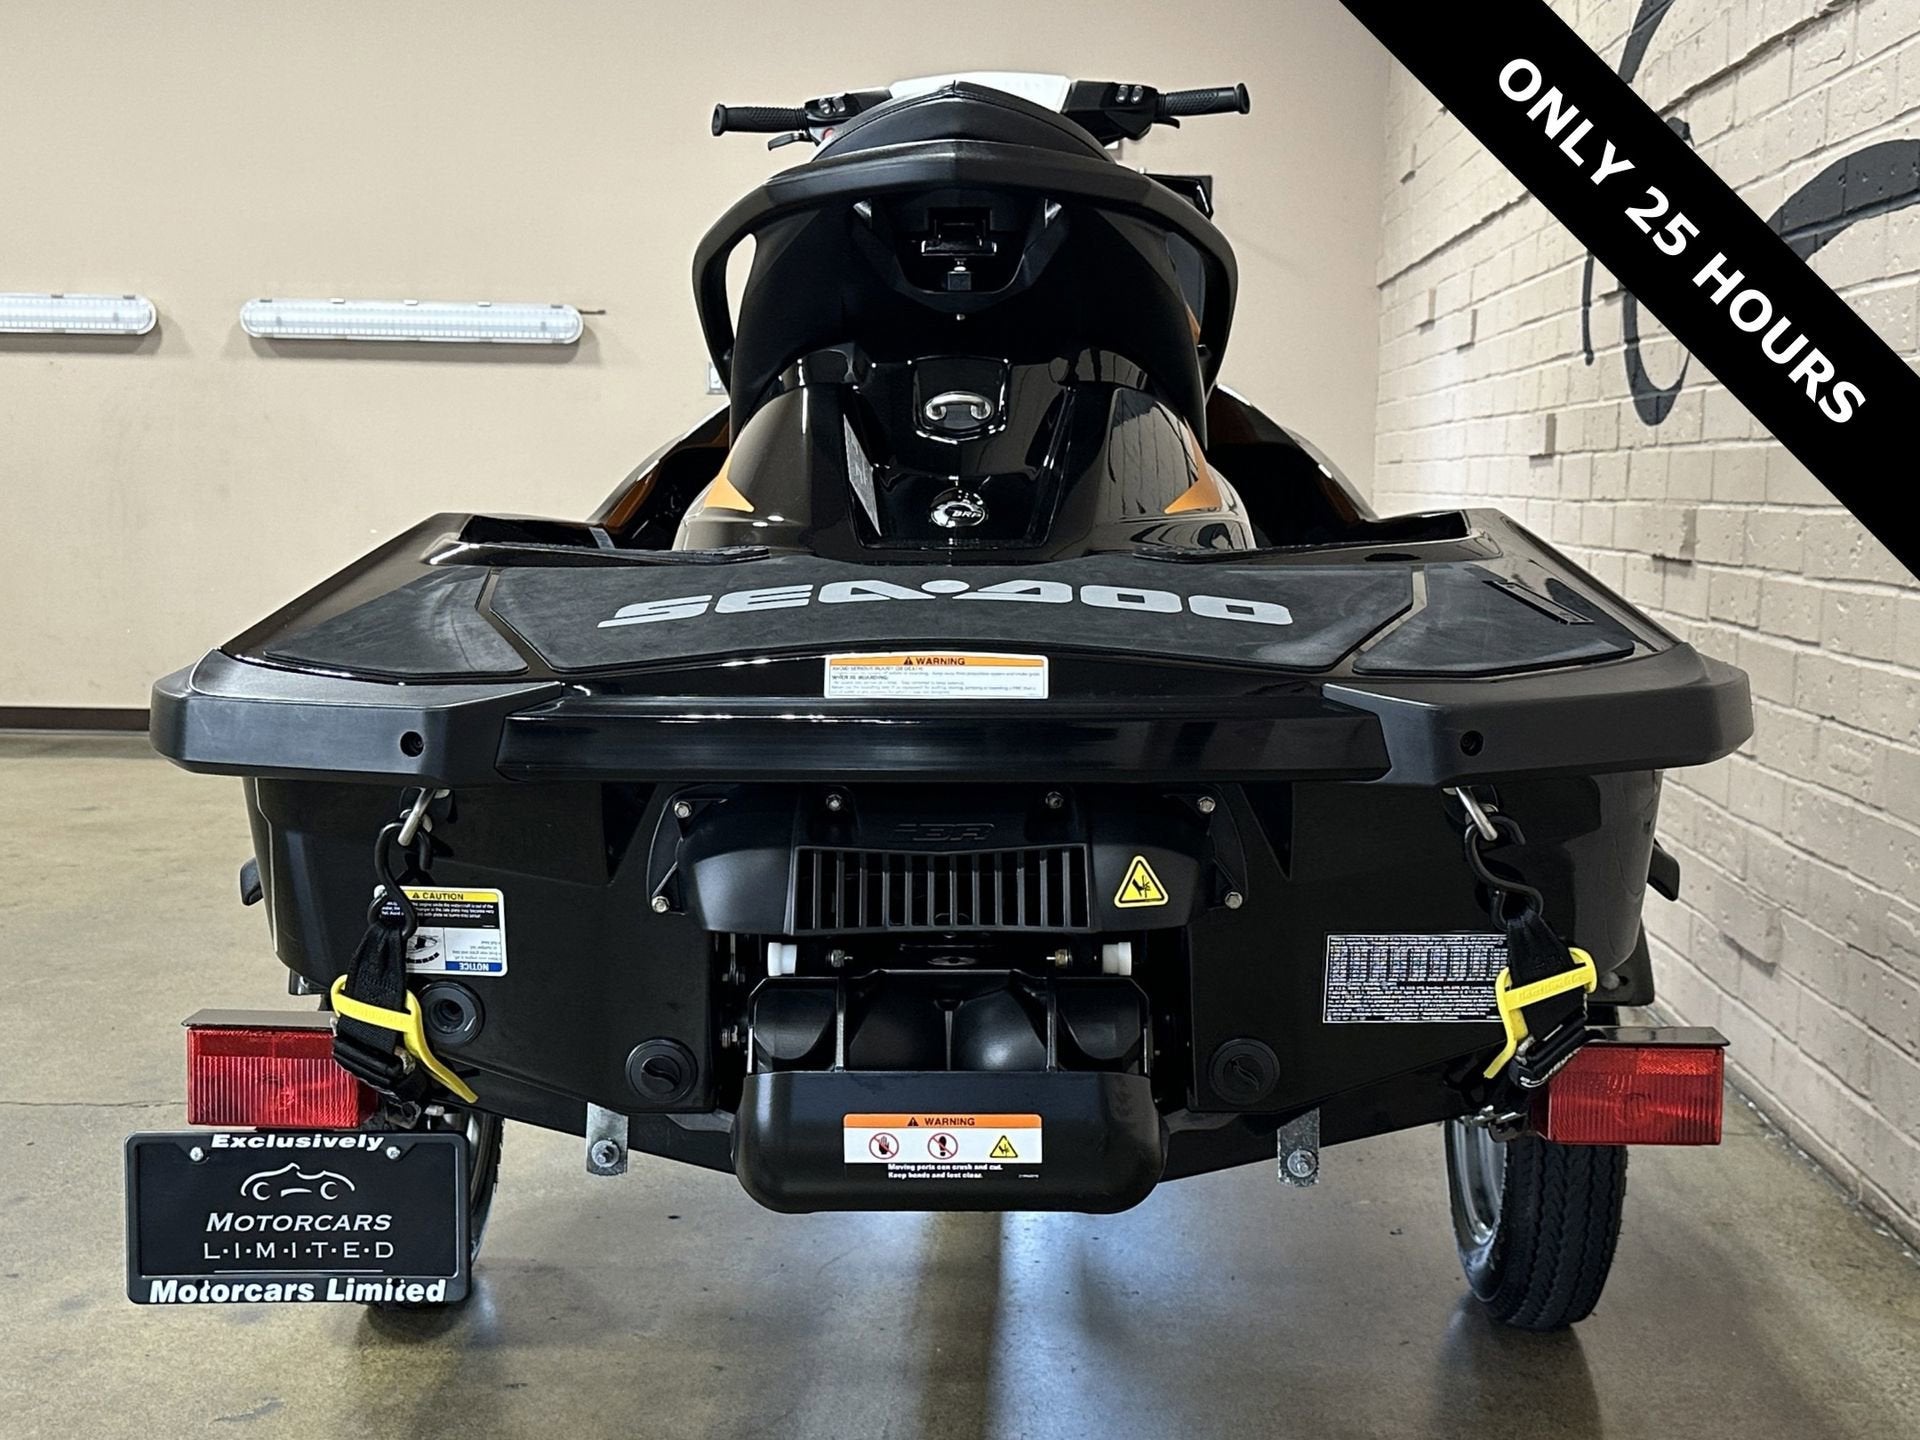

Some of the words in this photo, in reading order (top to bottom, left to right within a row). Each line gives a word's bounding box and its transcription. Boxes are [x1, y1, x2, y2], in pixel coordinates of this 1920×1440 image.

[916, 657, 966, 666] WARNING
[422, 892, 464, 900] CAUTION
[459, 962, 489, 971] NOTICE
[924, 1117, 976, 1126] WARNING
[211, 1134, 384, 1151] Exclusively
[888, 1163, 915, 1171] Moving
[206, 1212, 392, 1232] MOTORCARS
[149, 1279, 314, 1303] Motorcars
[326, 1279, 447, 1303] Limited
